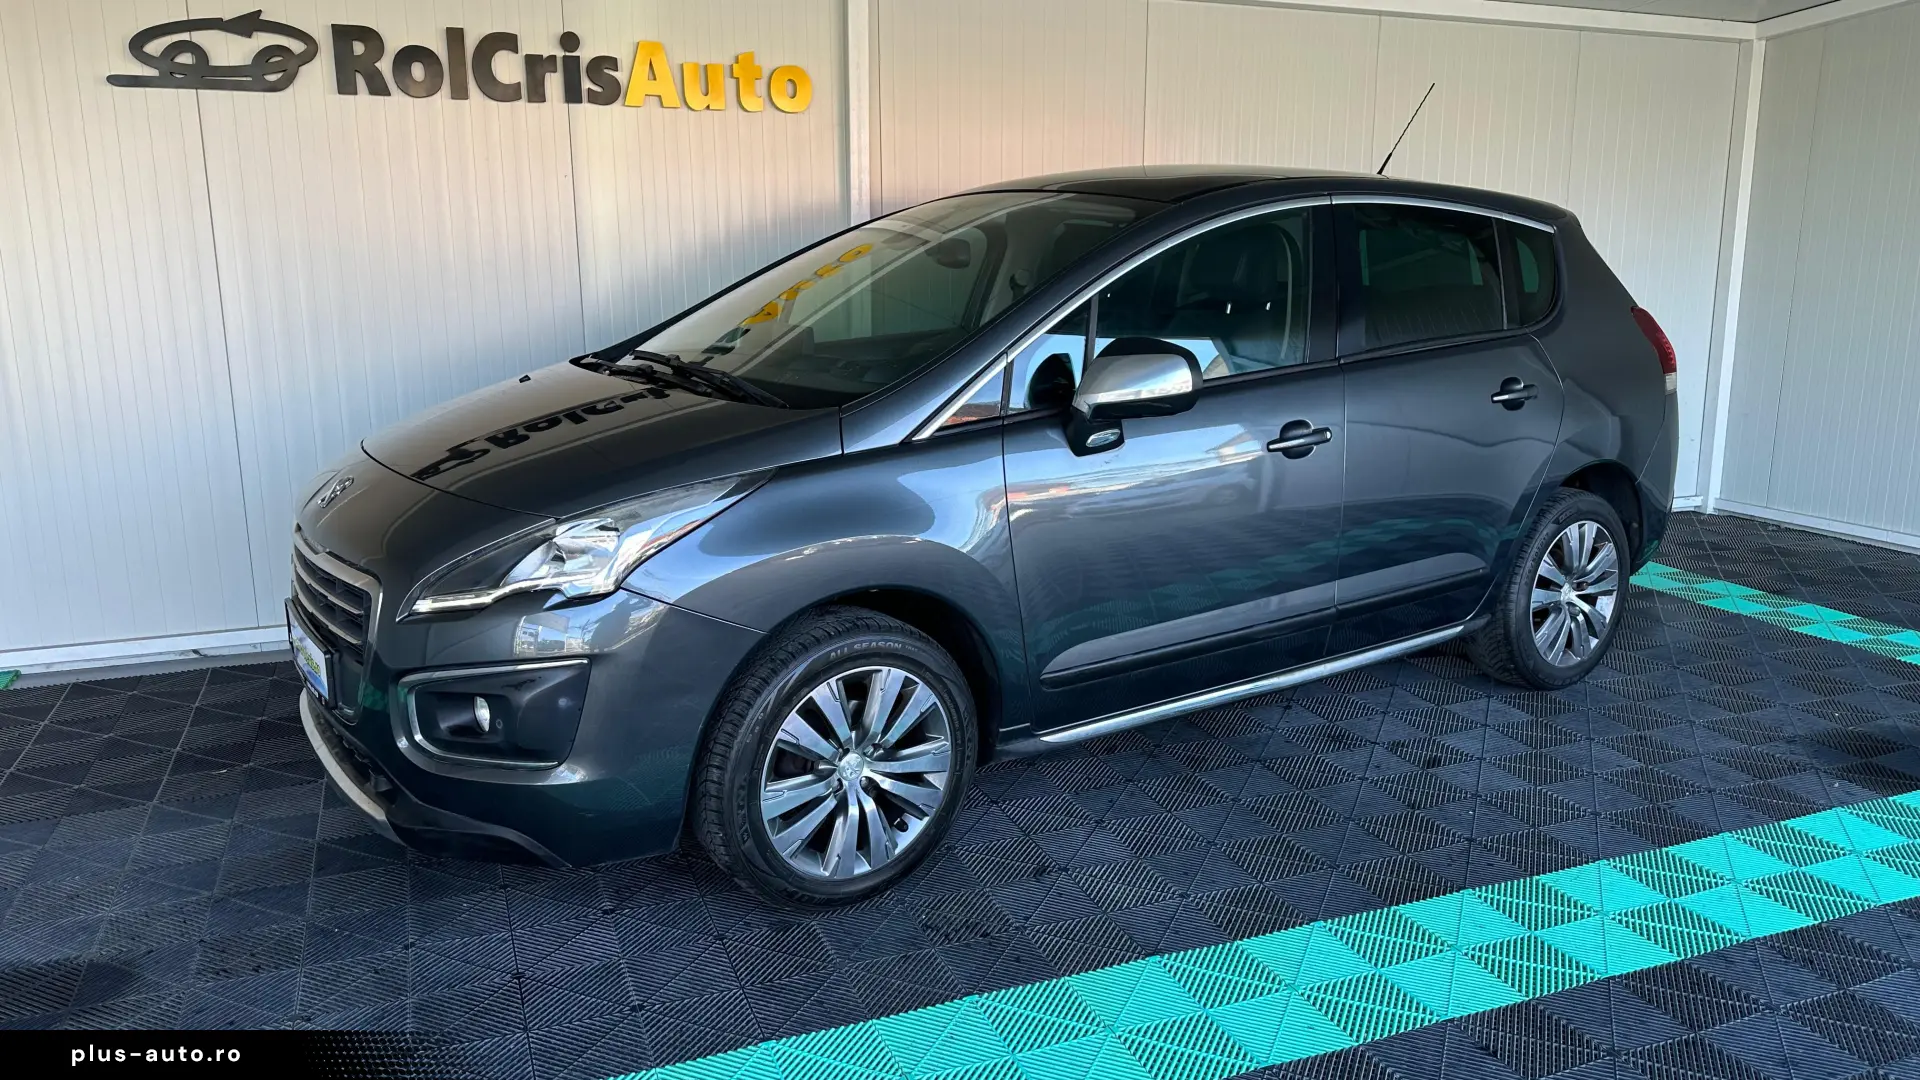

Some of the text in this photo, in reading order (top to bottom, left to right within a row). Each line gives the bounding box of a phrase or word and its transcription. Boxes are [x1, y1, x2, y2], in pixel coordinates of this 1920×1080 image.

[331, 23, 813, 114] RolCrisAuto
[830, 647, 848, 659] ALL
[853, 641, 902, 650] SEASON
